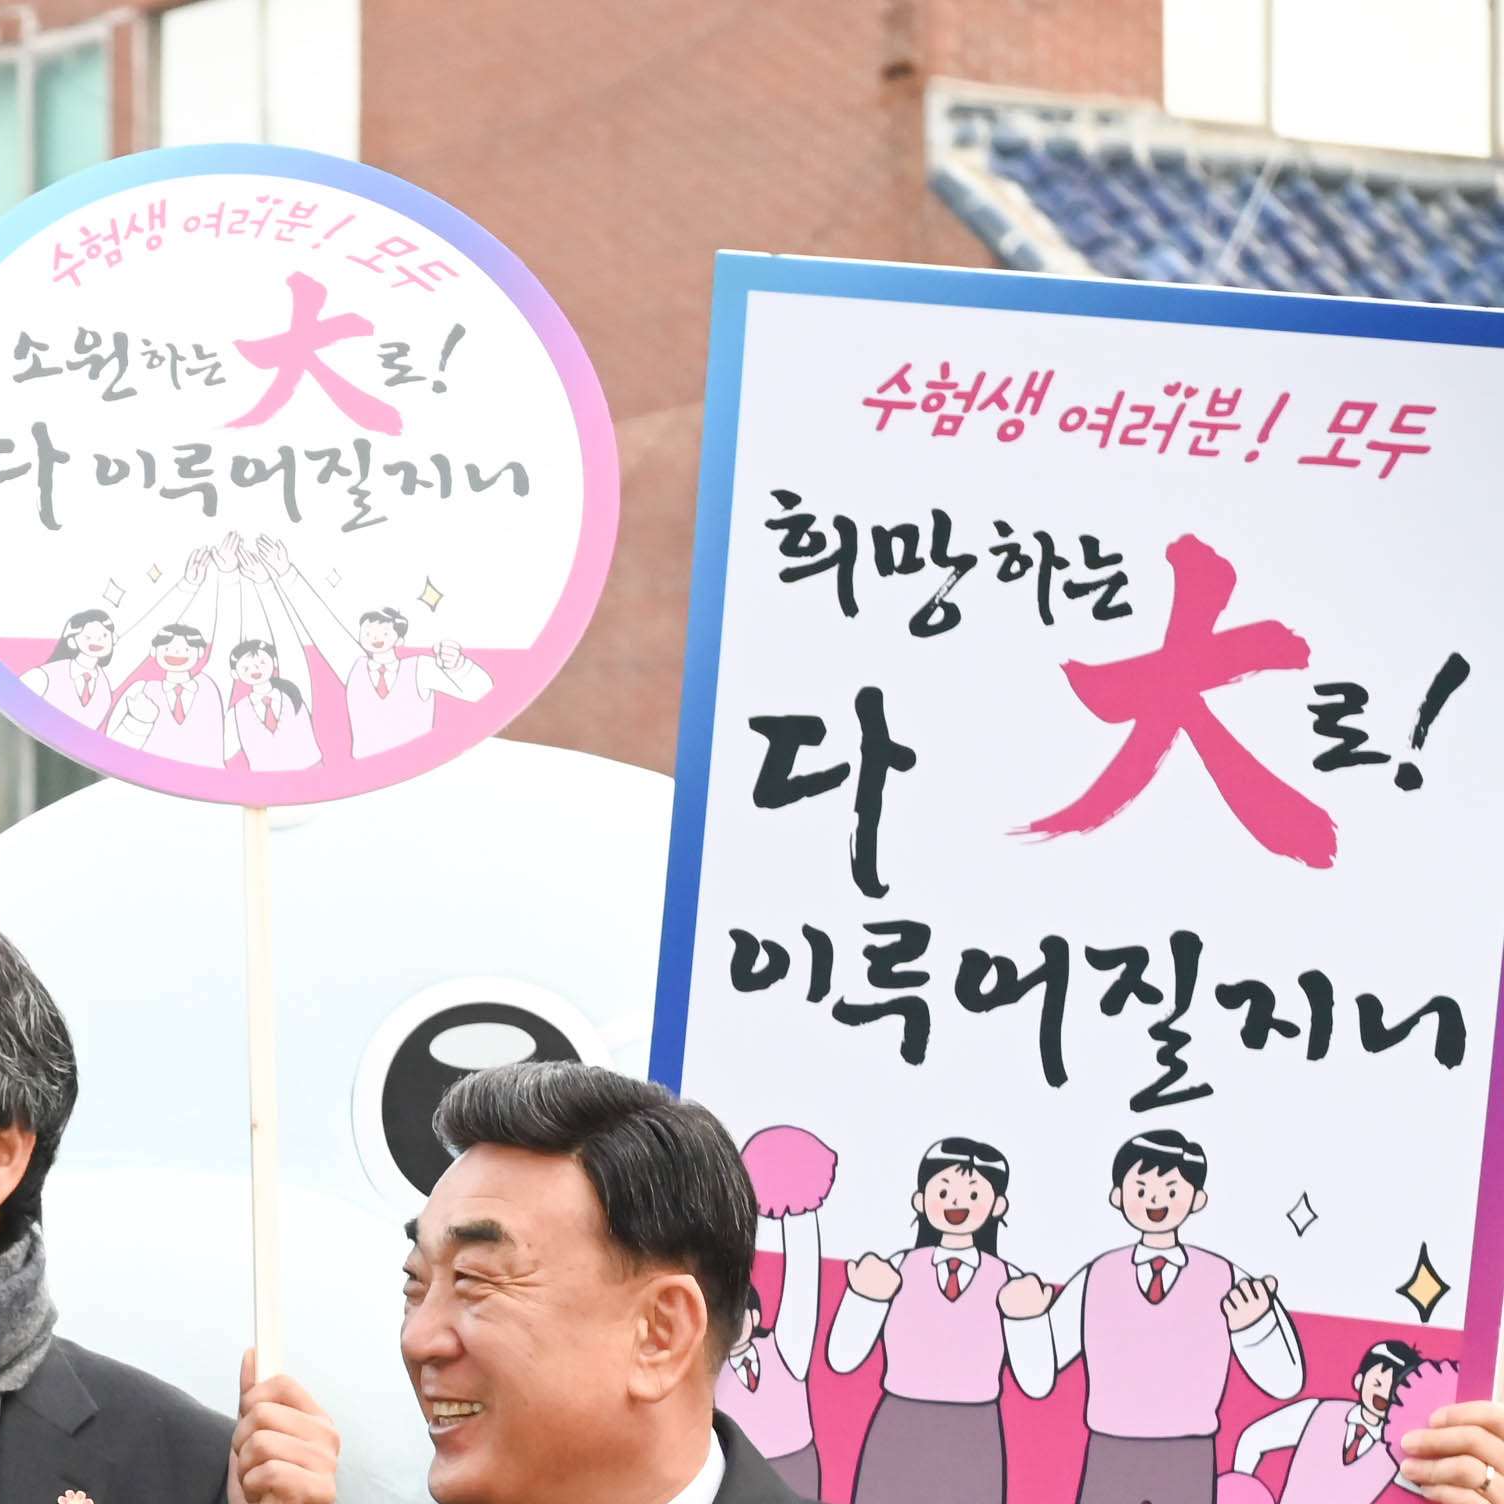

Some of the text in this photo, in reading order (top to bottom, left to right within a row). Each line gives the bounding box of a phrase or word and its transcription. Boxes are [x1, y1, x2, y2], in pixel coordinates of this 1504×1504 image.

[52, 195, 460, 292] 수험생 여러분! 모두
[13, 327, 226, 402] 소원하는
[862, 360, 1439, 481] 수험생 여러분! 모두
[93, 438, 530, 533] 이루어질지니
[764, 489, 1133, 639] 희망하는
[748, 686, 917, 899] 다
[728, 919, 1467, 1113] 이루어질지니
